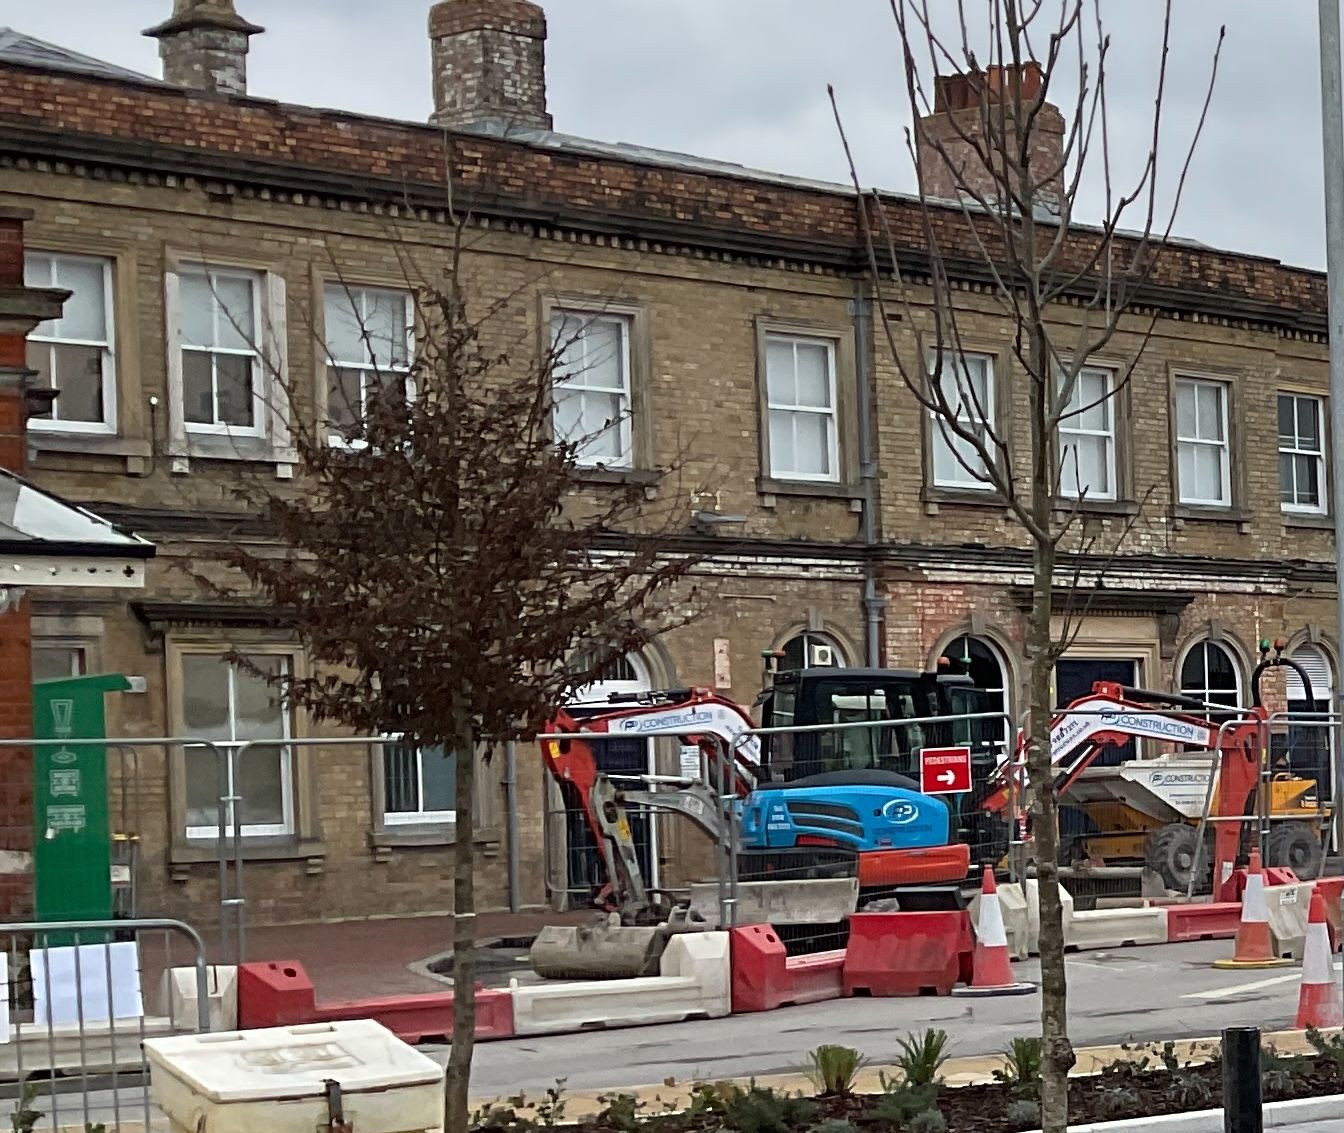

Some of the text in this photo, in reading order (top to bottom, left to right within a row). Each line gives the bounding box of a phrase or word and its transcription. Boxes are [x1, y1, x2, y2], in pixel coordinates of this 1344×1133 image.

[642, 711, 712, 729] CONSTRUCTION
[1121, 713, 1194, 736] CONSTRUCTION
[1164, 774, 1210, 783] CONSTRUCTIO
